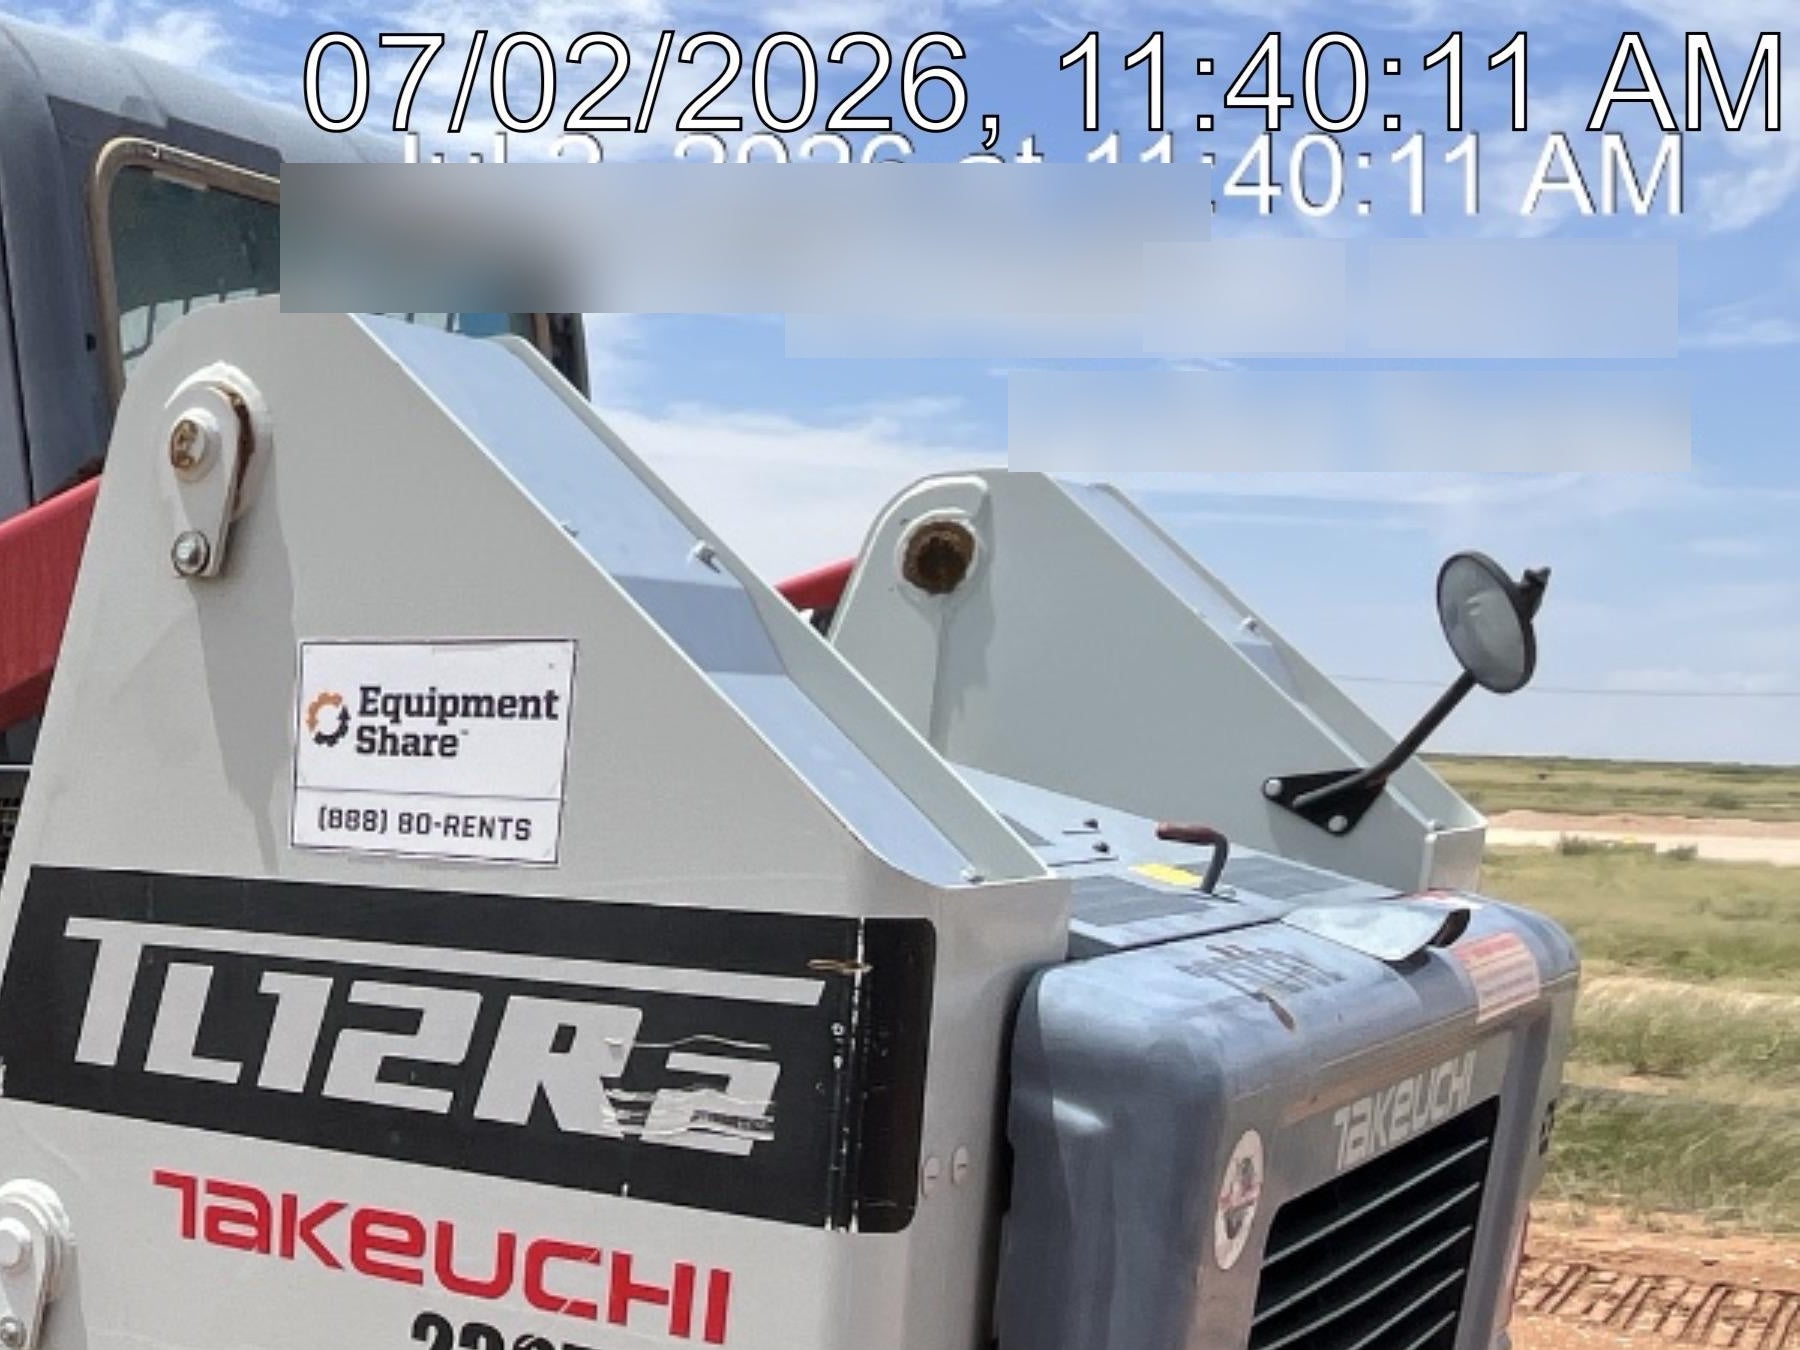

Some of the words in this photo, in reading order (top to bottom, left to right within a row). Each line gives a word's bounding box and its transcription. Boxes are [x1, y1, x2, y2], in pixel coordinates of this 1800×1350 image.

[358, 686, 560, 726] Equipment
[355, 725, 459, 757] Share
[317, 804, 388, 835] (888)
[397, 811, 532, 841] 80-RENTS
